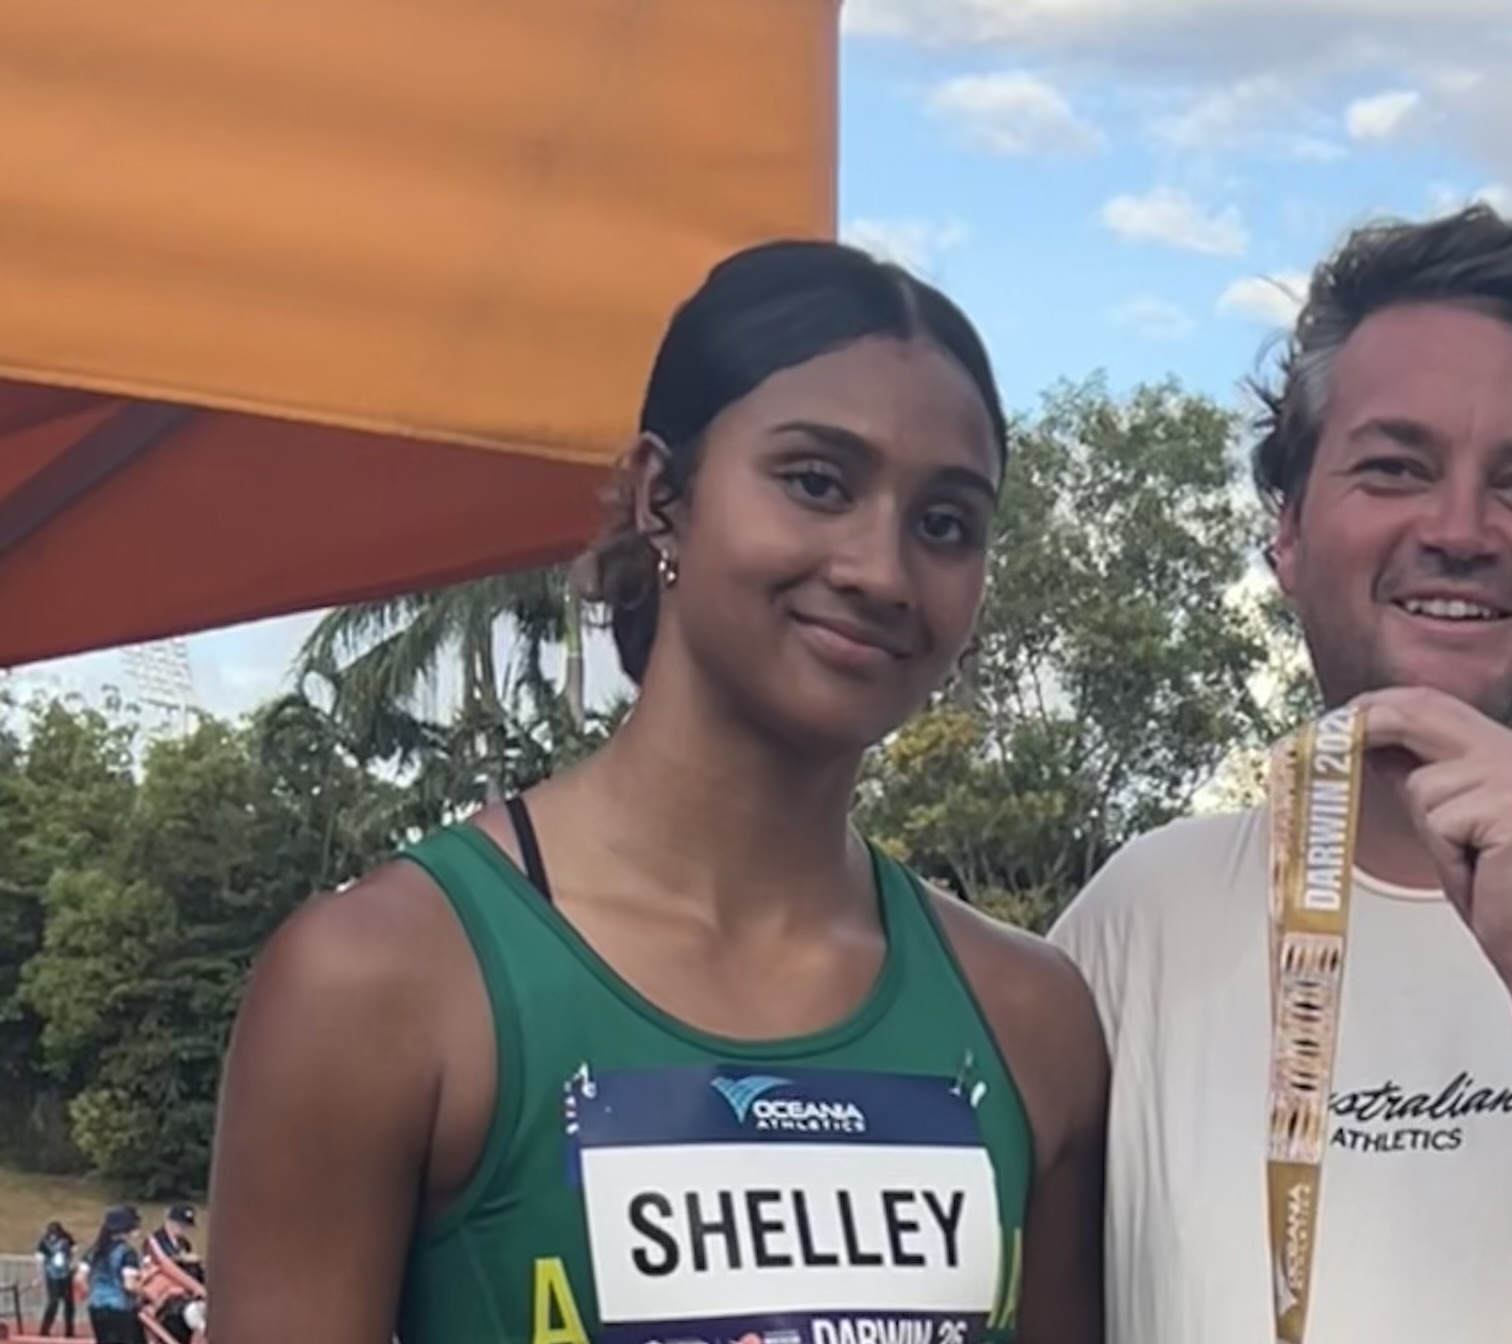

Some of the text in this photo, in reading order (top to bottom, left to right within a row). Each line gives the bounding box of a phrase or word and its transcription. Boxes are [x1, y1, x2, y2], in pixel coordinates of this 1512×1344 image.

[1305, 780, 1350, 910] DARWIN
[753, 1099, 865, 1121] OCEANIA
[757, 1119, 866, 1132] ATHLETICS
[1331, 1127, 1463, 1152] ATHLETICS
[628, 1191, 964, 1277] SHELLEY
